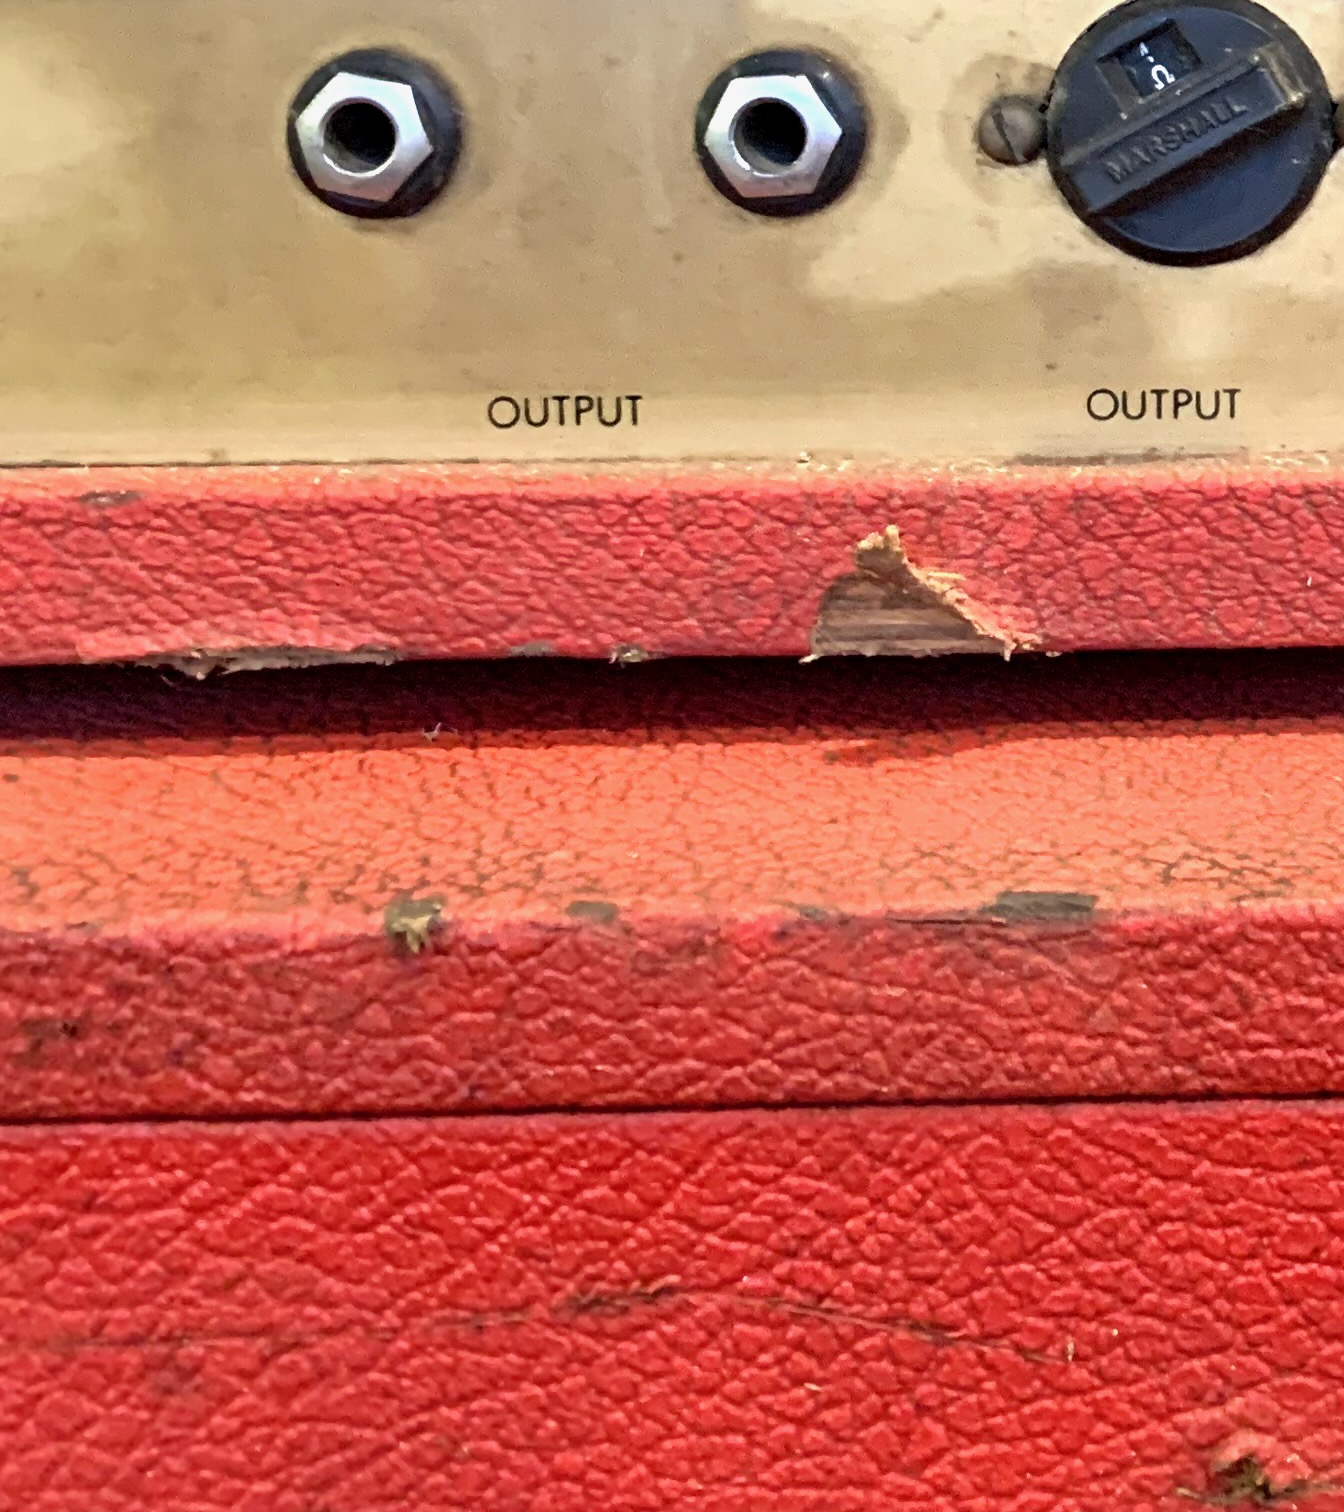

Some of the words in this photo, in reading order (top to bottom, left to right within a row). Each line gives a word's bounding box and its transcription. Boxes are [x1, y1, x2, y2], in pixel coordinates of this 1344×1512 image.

[1103, 97, 1249, 185] MARSHALL
[486, 393, 644, 430] OUTPUT
[1085, 387, 1242, 422] OUTPUT
